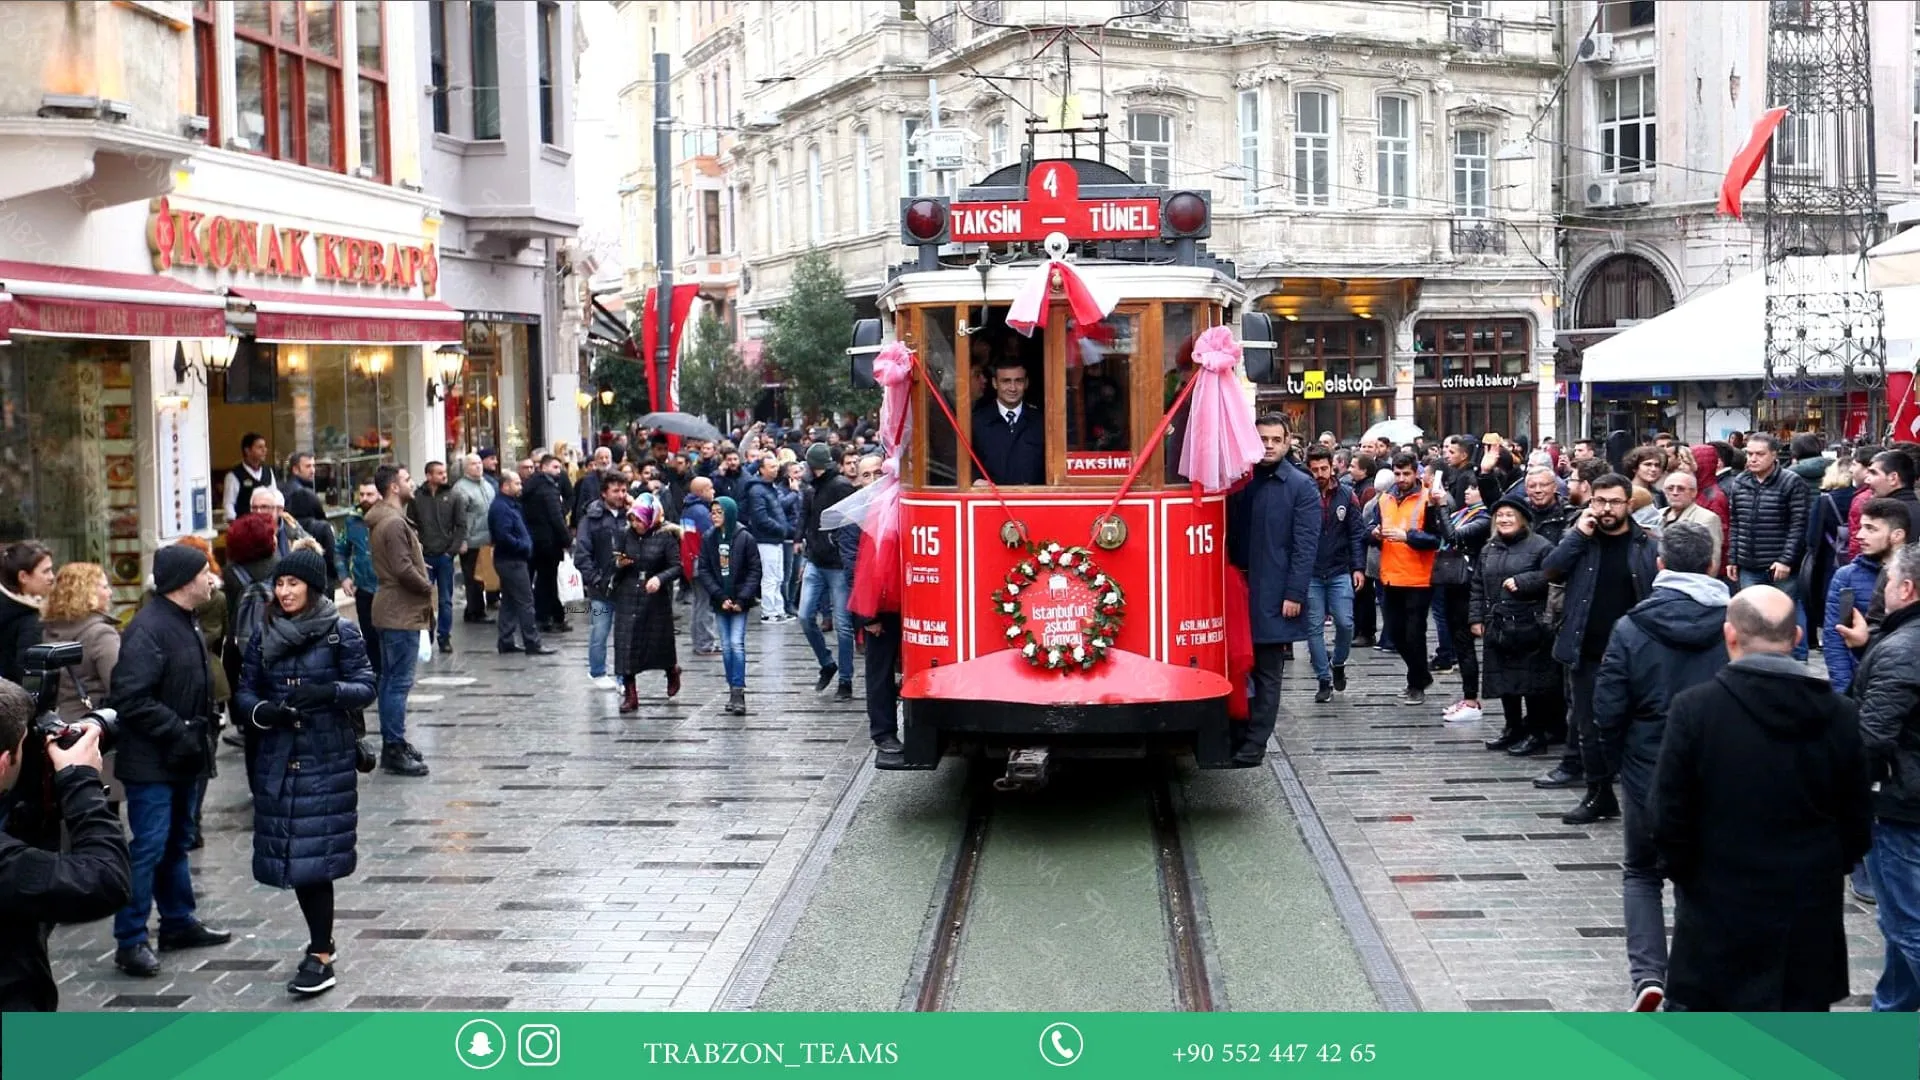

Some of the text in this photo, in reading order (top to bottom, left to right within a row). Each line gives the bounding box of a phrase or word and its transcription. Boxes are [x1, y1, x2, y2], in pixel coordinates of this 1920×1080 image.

[1043, 168, 1058, 198] 4
[951, 205, 1022, 235] TAKSİM
[1089, 203, 1156, 232] TÜNEL
[172, 208, 425, 288] KONAK KEBAP
[1287, 372, 1373, 397] tunnelstop
[1066, 456, 1127, 470] TAKSİM
[911, 525, 940, 556] 115
[1185, 524, 1214, 555] 115
[1175, 634, 1188, 646] VE
